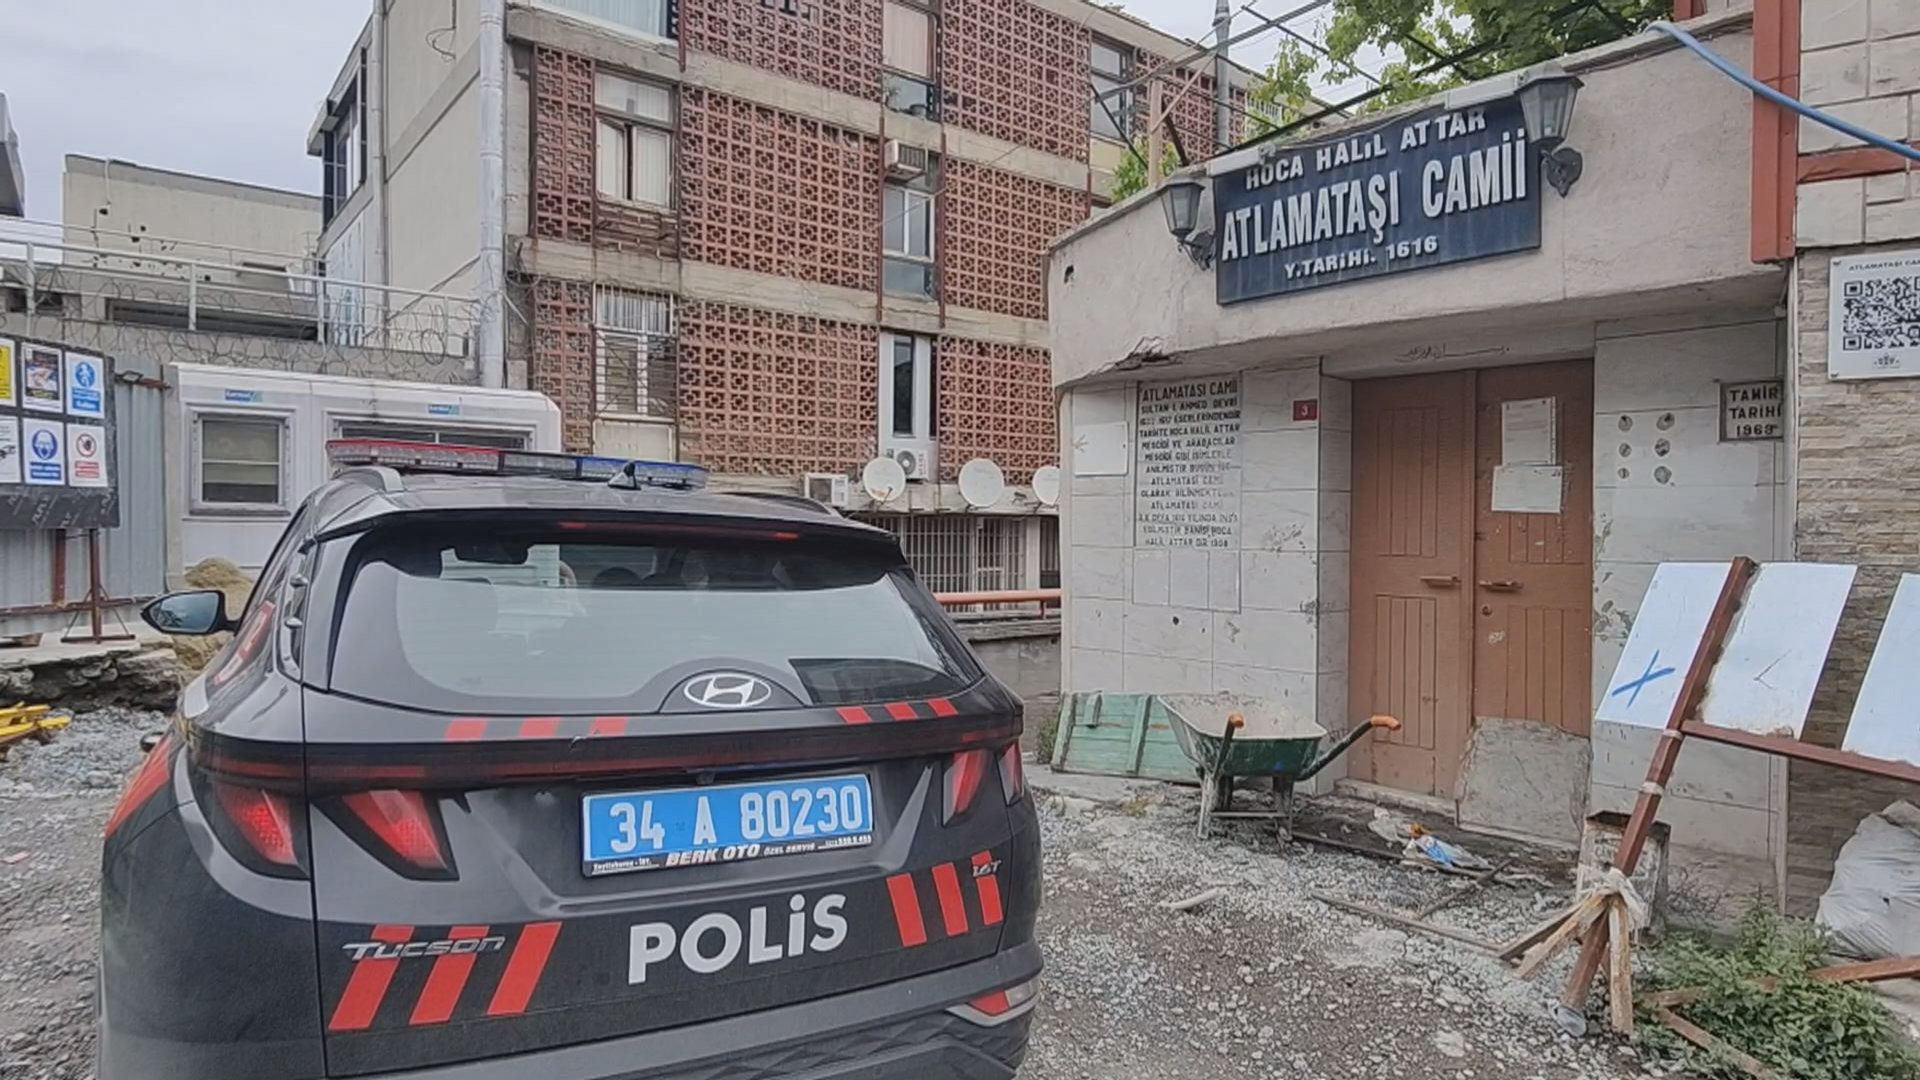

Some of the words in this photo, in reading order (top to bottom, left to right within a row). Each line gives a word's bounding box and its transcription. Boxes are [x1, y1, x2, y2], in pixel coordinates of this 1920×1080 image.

[1246, 155, 1304, 190] HOCA
[1400, 107, 1487, 151] ATTAR
[1222, 170, 1400, 261] ATLAMATAŞI
[1385, 235, 1438, 261] 1616
[1301, 404, 1309, 418] 3
[1214, 422, 1241, 434] ATTAR
[610, 801, 665, 853] 34
[693, 796, 717, 845] A
[740, 785, 863, 840] 80230
[665, 847, 719, 867] BERK
[722, 844, 760, 860] OTO
[342, 936, 506, 960] TUCSON
